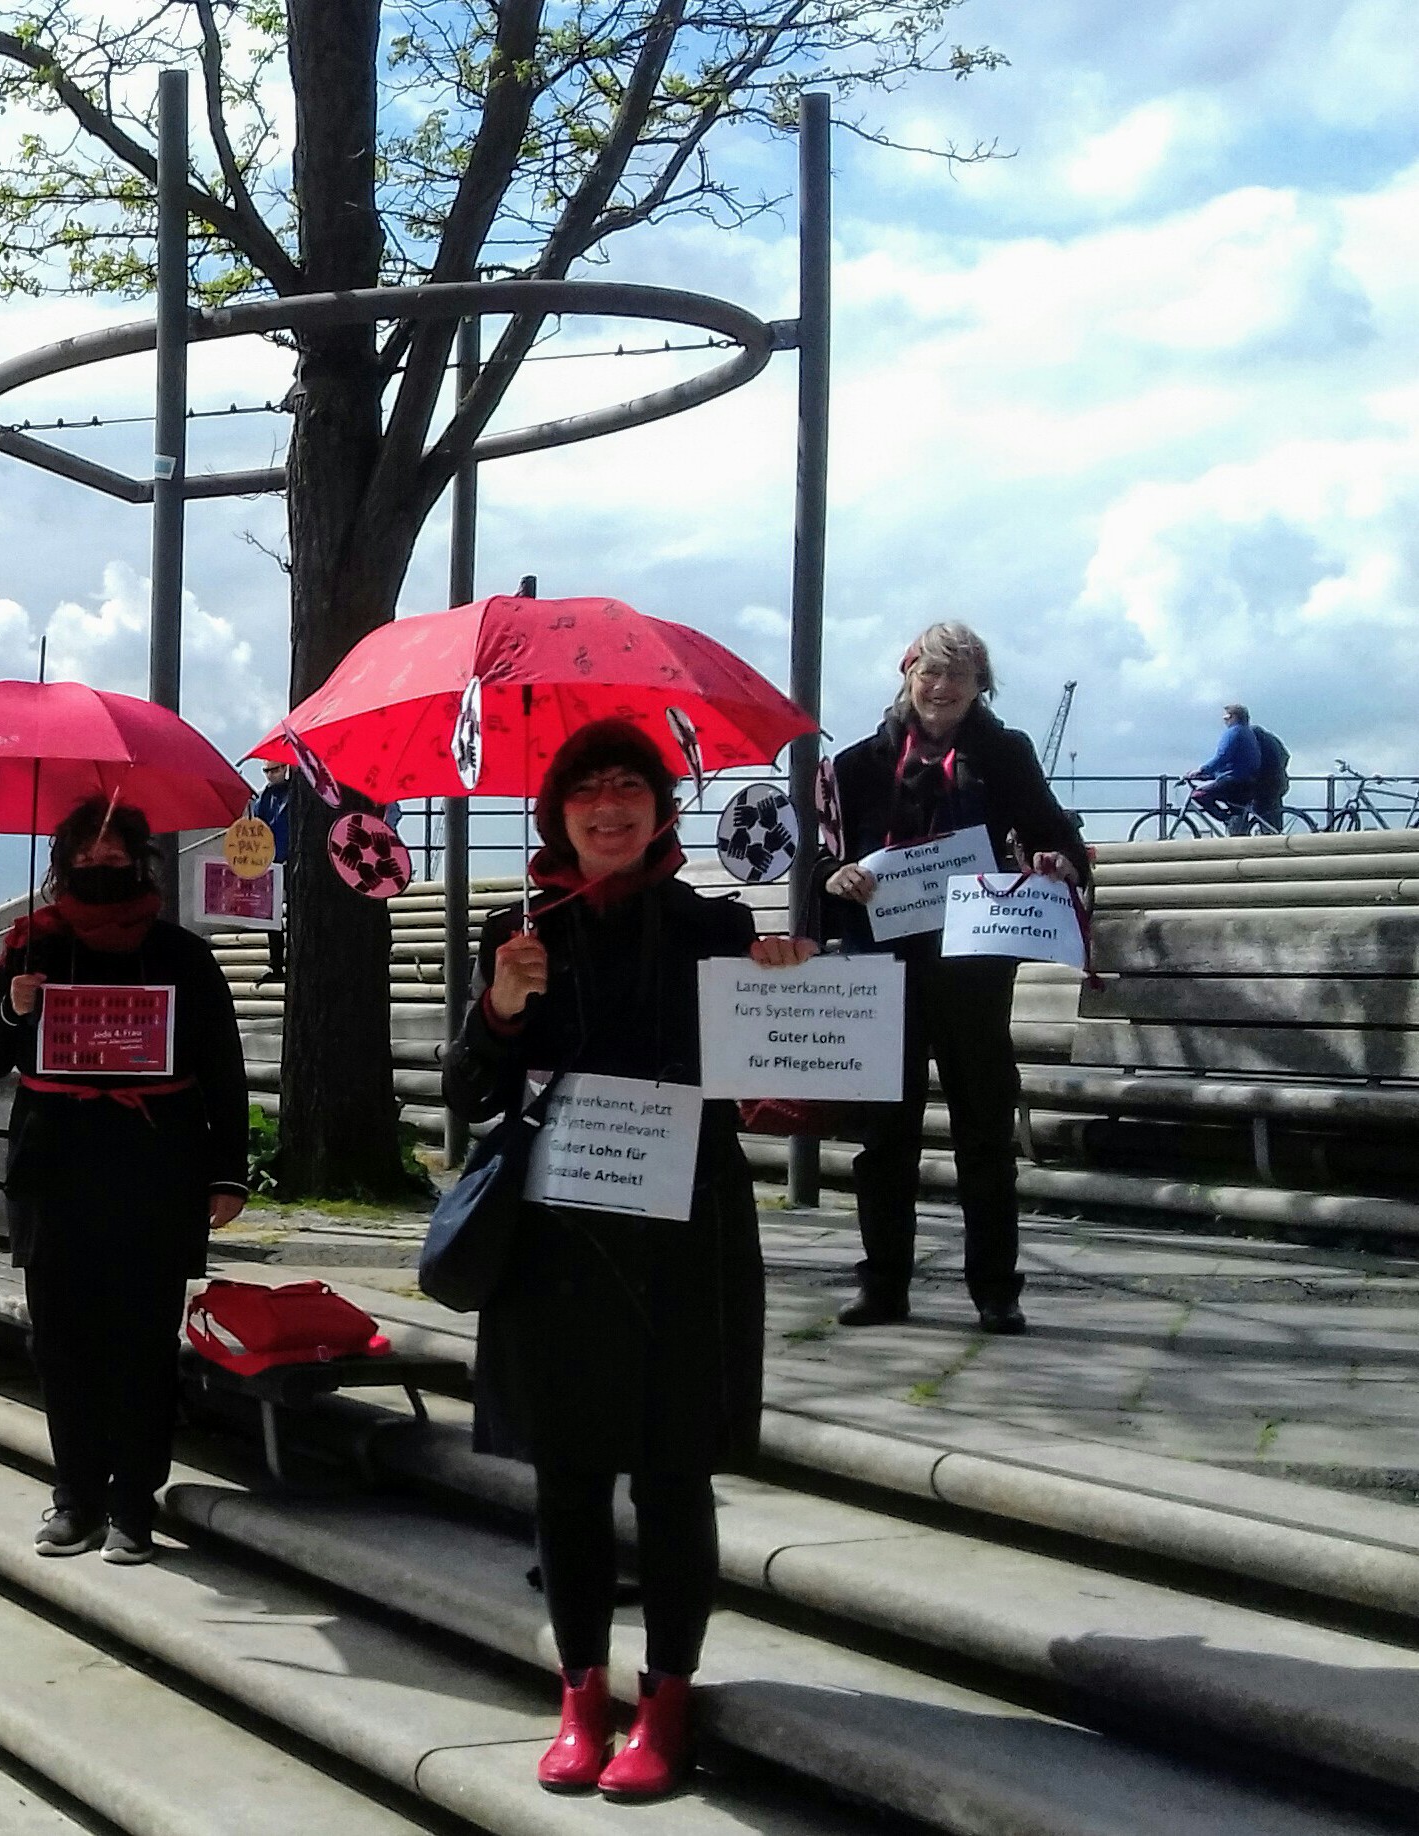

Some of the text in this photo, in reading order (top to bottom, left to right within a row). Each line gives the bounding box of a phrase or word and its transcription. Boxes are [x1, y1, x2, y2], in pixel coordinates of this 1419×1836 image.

[235, 824, 264, 838] FAIR
[238, 841, 261, 855] PAY
[903, 844, 940, 861] Keine
[876, 852, 977, 883] Privatisierungen
[923, 880, 939, 892] im
[989, 904, 1043, 918] Berufe
[972, 922, 1057, 940] aufwerten!
[736, 980, 878, 998] Lange verkannt, jetzt
[735, 1003, 878, 1019] fürs System relevant:
[768, 1030, 846, 1044] Guter Lohn
[749, 1055, 863, 1071] für Pflegeberufe
[576, 1096, 638, 1114] verkannt,
[640, 1103, 672, 1116] jetzt
[609, 1122, 670, 1139] relevant:
[589, 1143, 622, 1157] Lohn
[626, 1147, 648, 1160] für
[547, 1164, 643, 1186] Soziale Arbeit!
